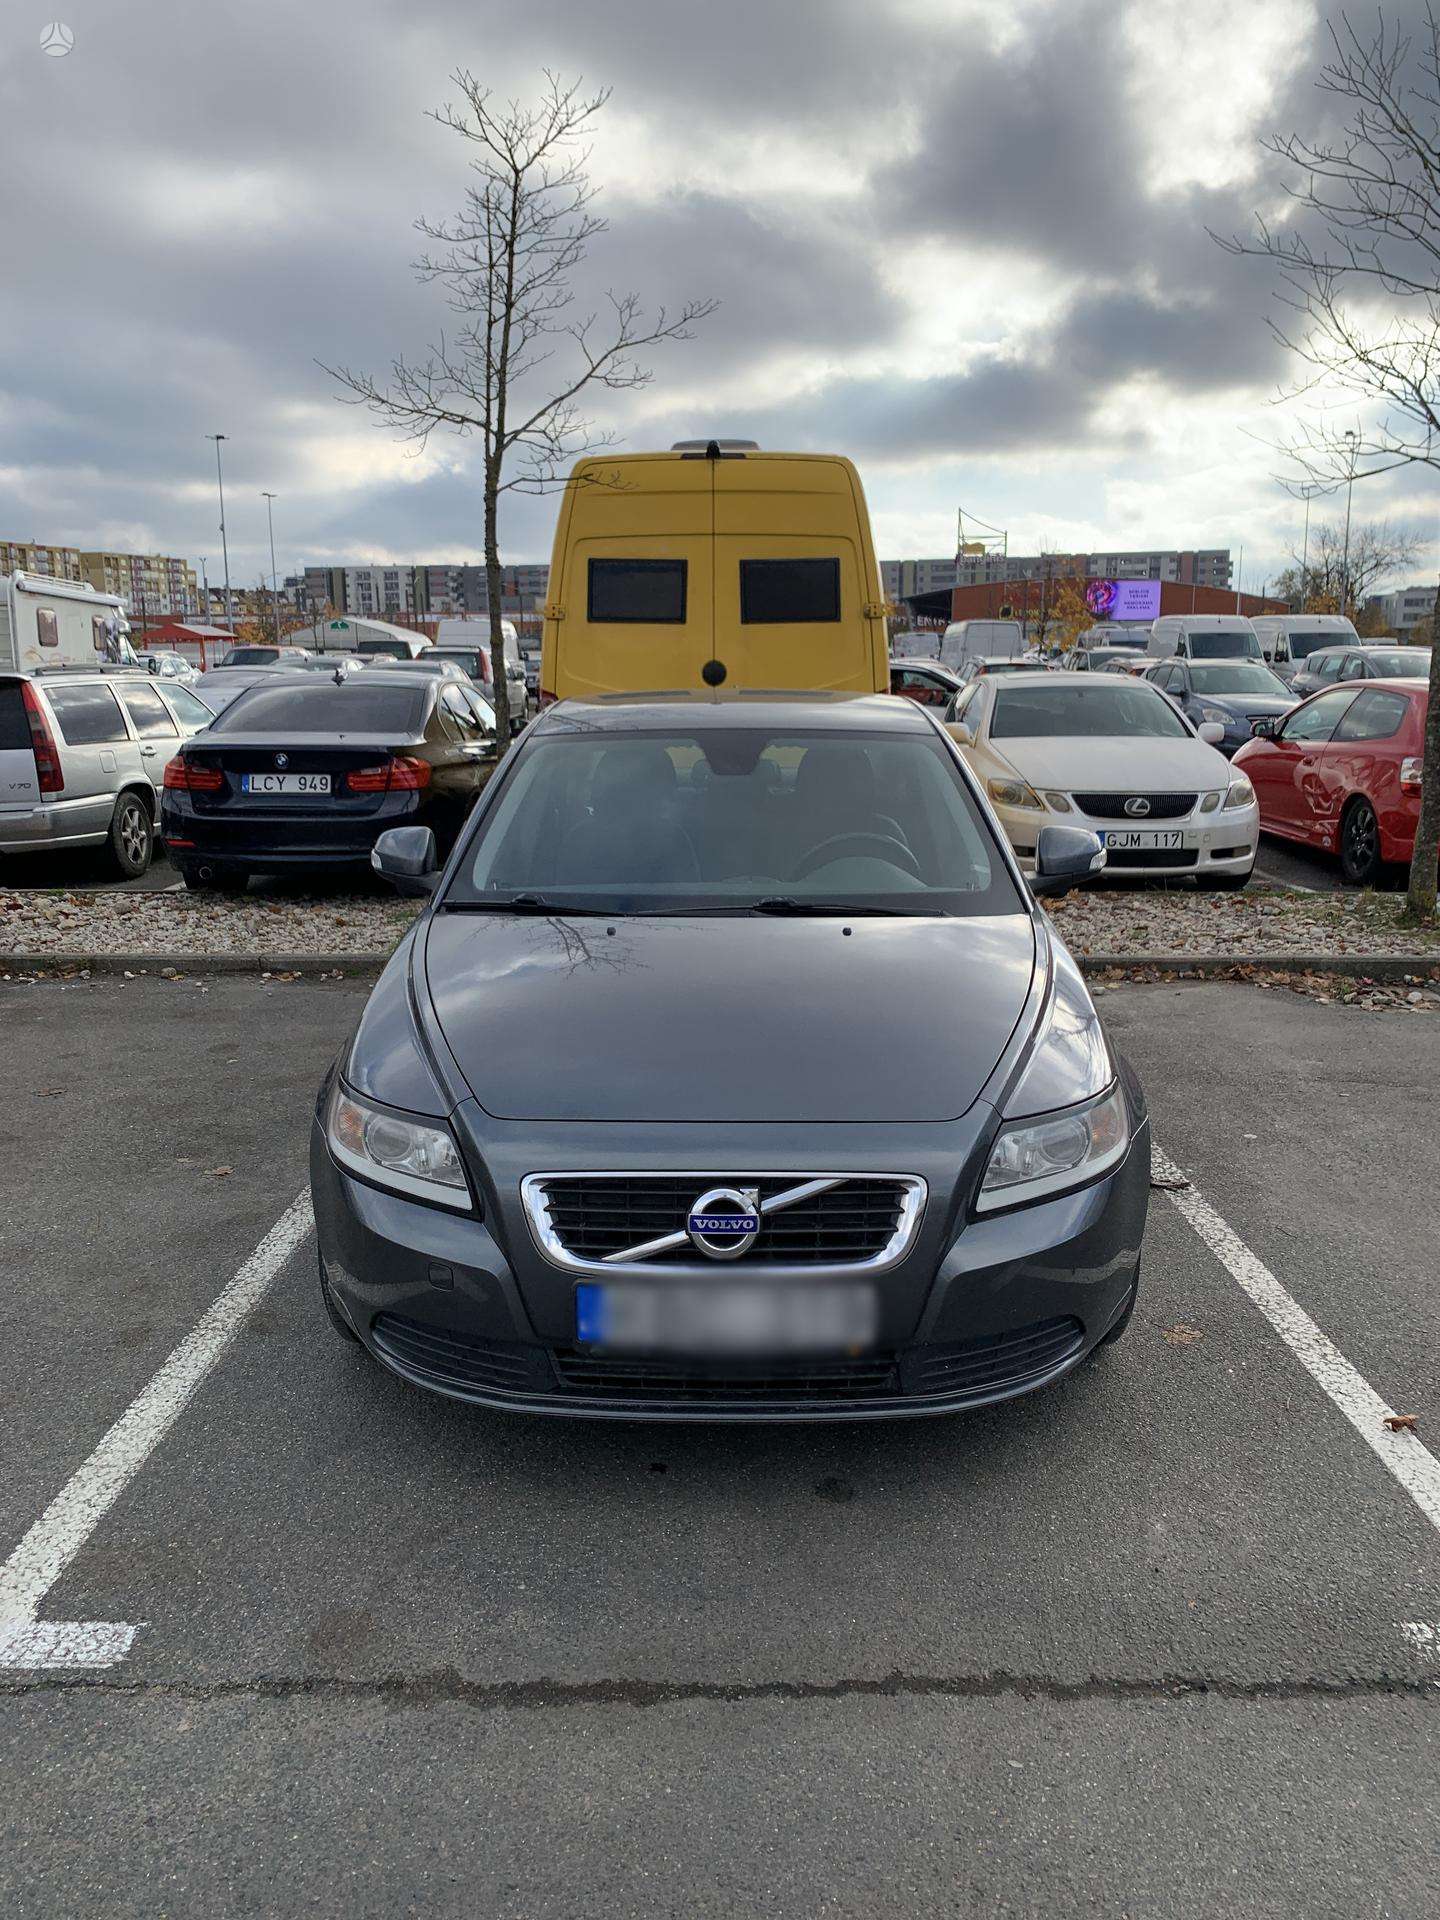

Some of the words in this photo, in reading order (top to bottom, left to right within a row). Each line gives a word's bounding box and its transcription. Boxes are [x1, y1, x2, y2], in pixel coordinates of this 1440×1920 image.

[8, 782, 32, 790] V70
[250, 776, 287, 791] LCY
[298, 776, 329, 791] 949
[1107, 833, 1141, 847] GJM
[1153, 833, 1180, 847] 117
[693, 1219, 755, 1229] VOLVO
